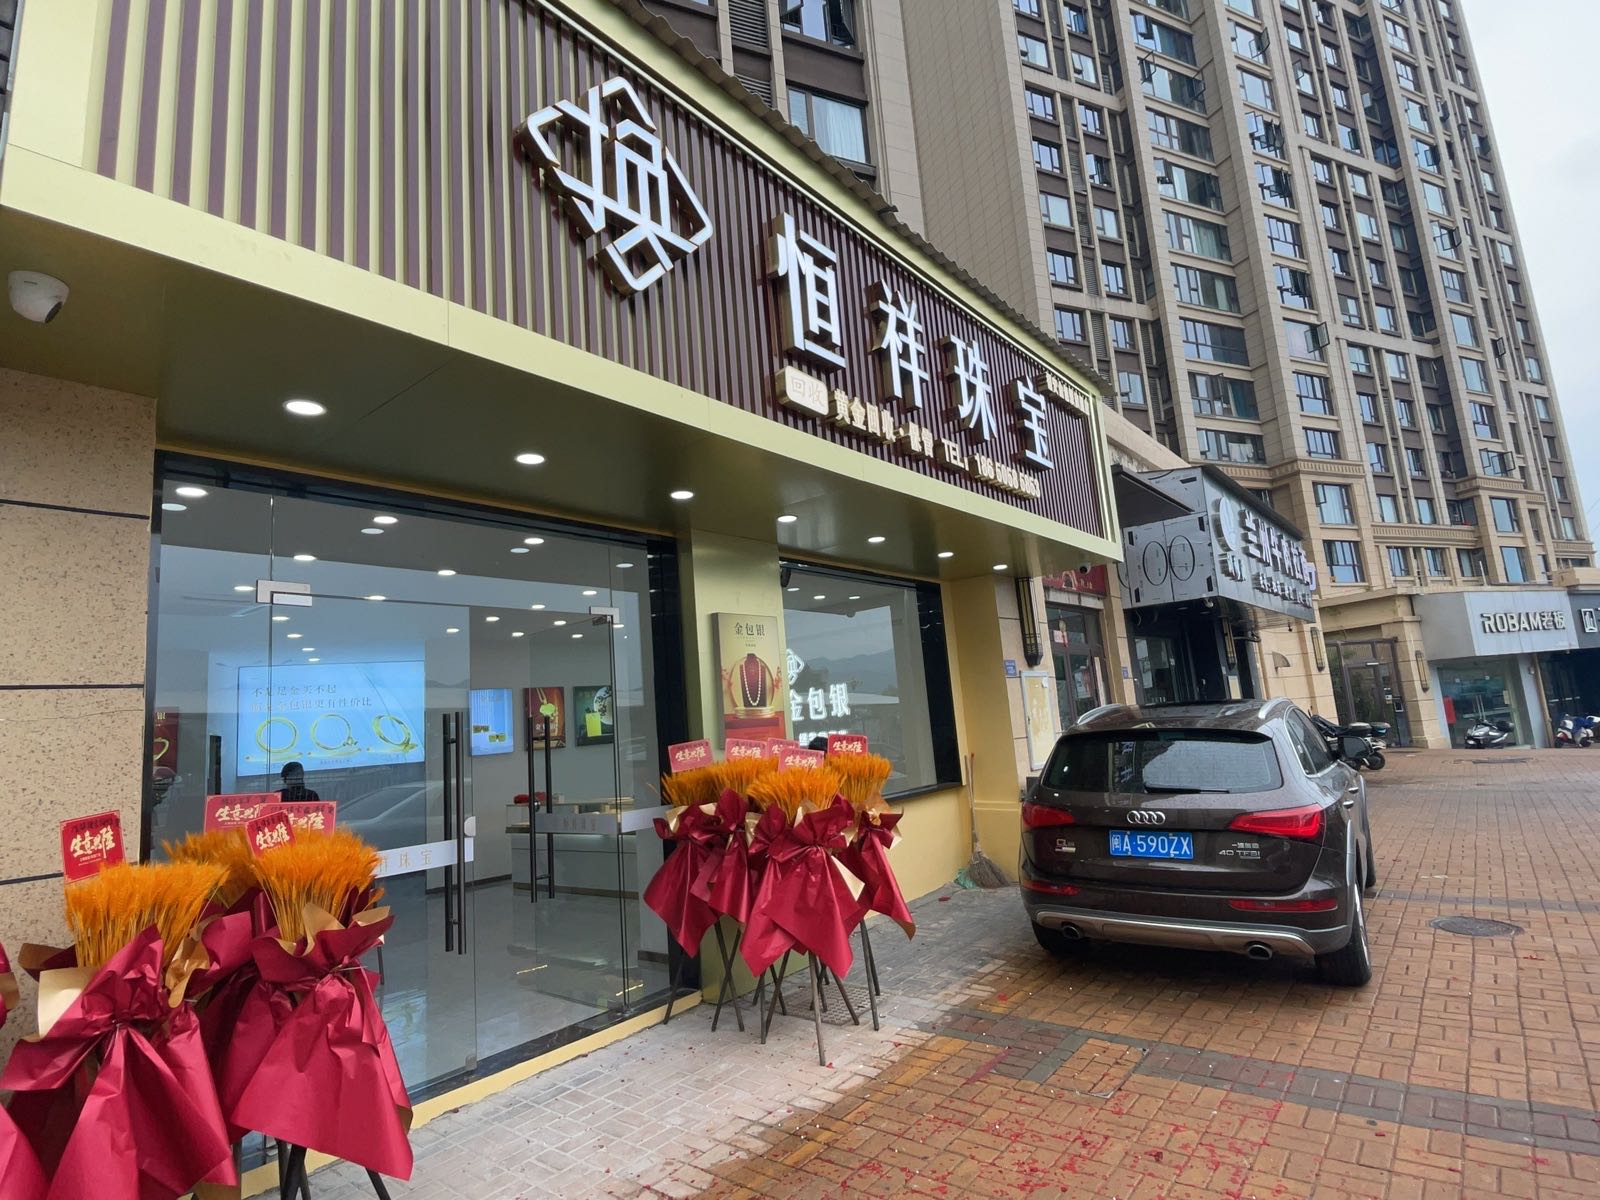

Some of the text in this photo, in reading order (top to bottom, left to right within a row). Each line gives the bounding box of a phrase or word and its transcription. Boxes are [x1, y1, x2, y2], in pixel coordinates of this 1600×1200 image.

[776, 212, 1054, 470] 恒祥珠宝
[790, 375, 825, 408] 回收
[734, 621, 766, 637] 金包银
[789, 682, 851, 721] 金包银
